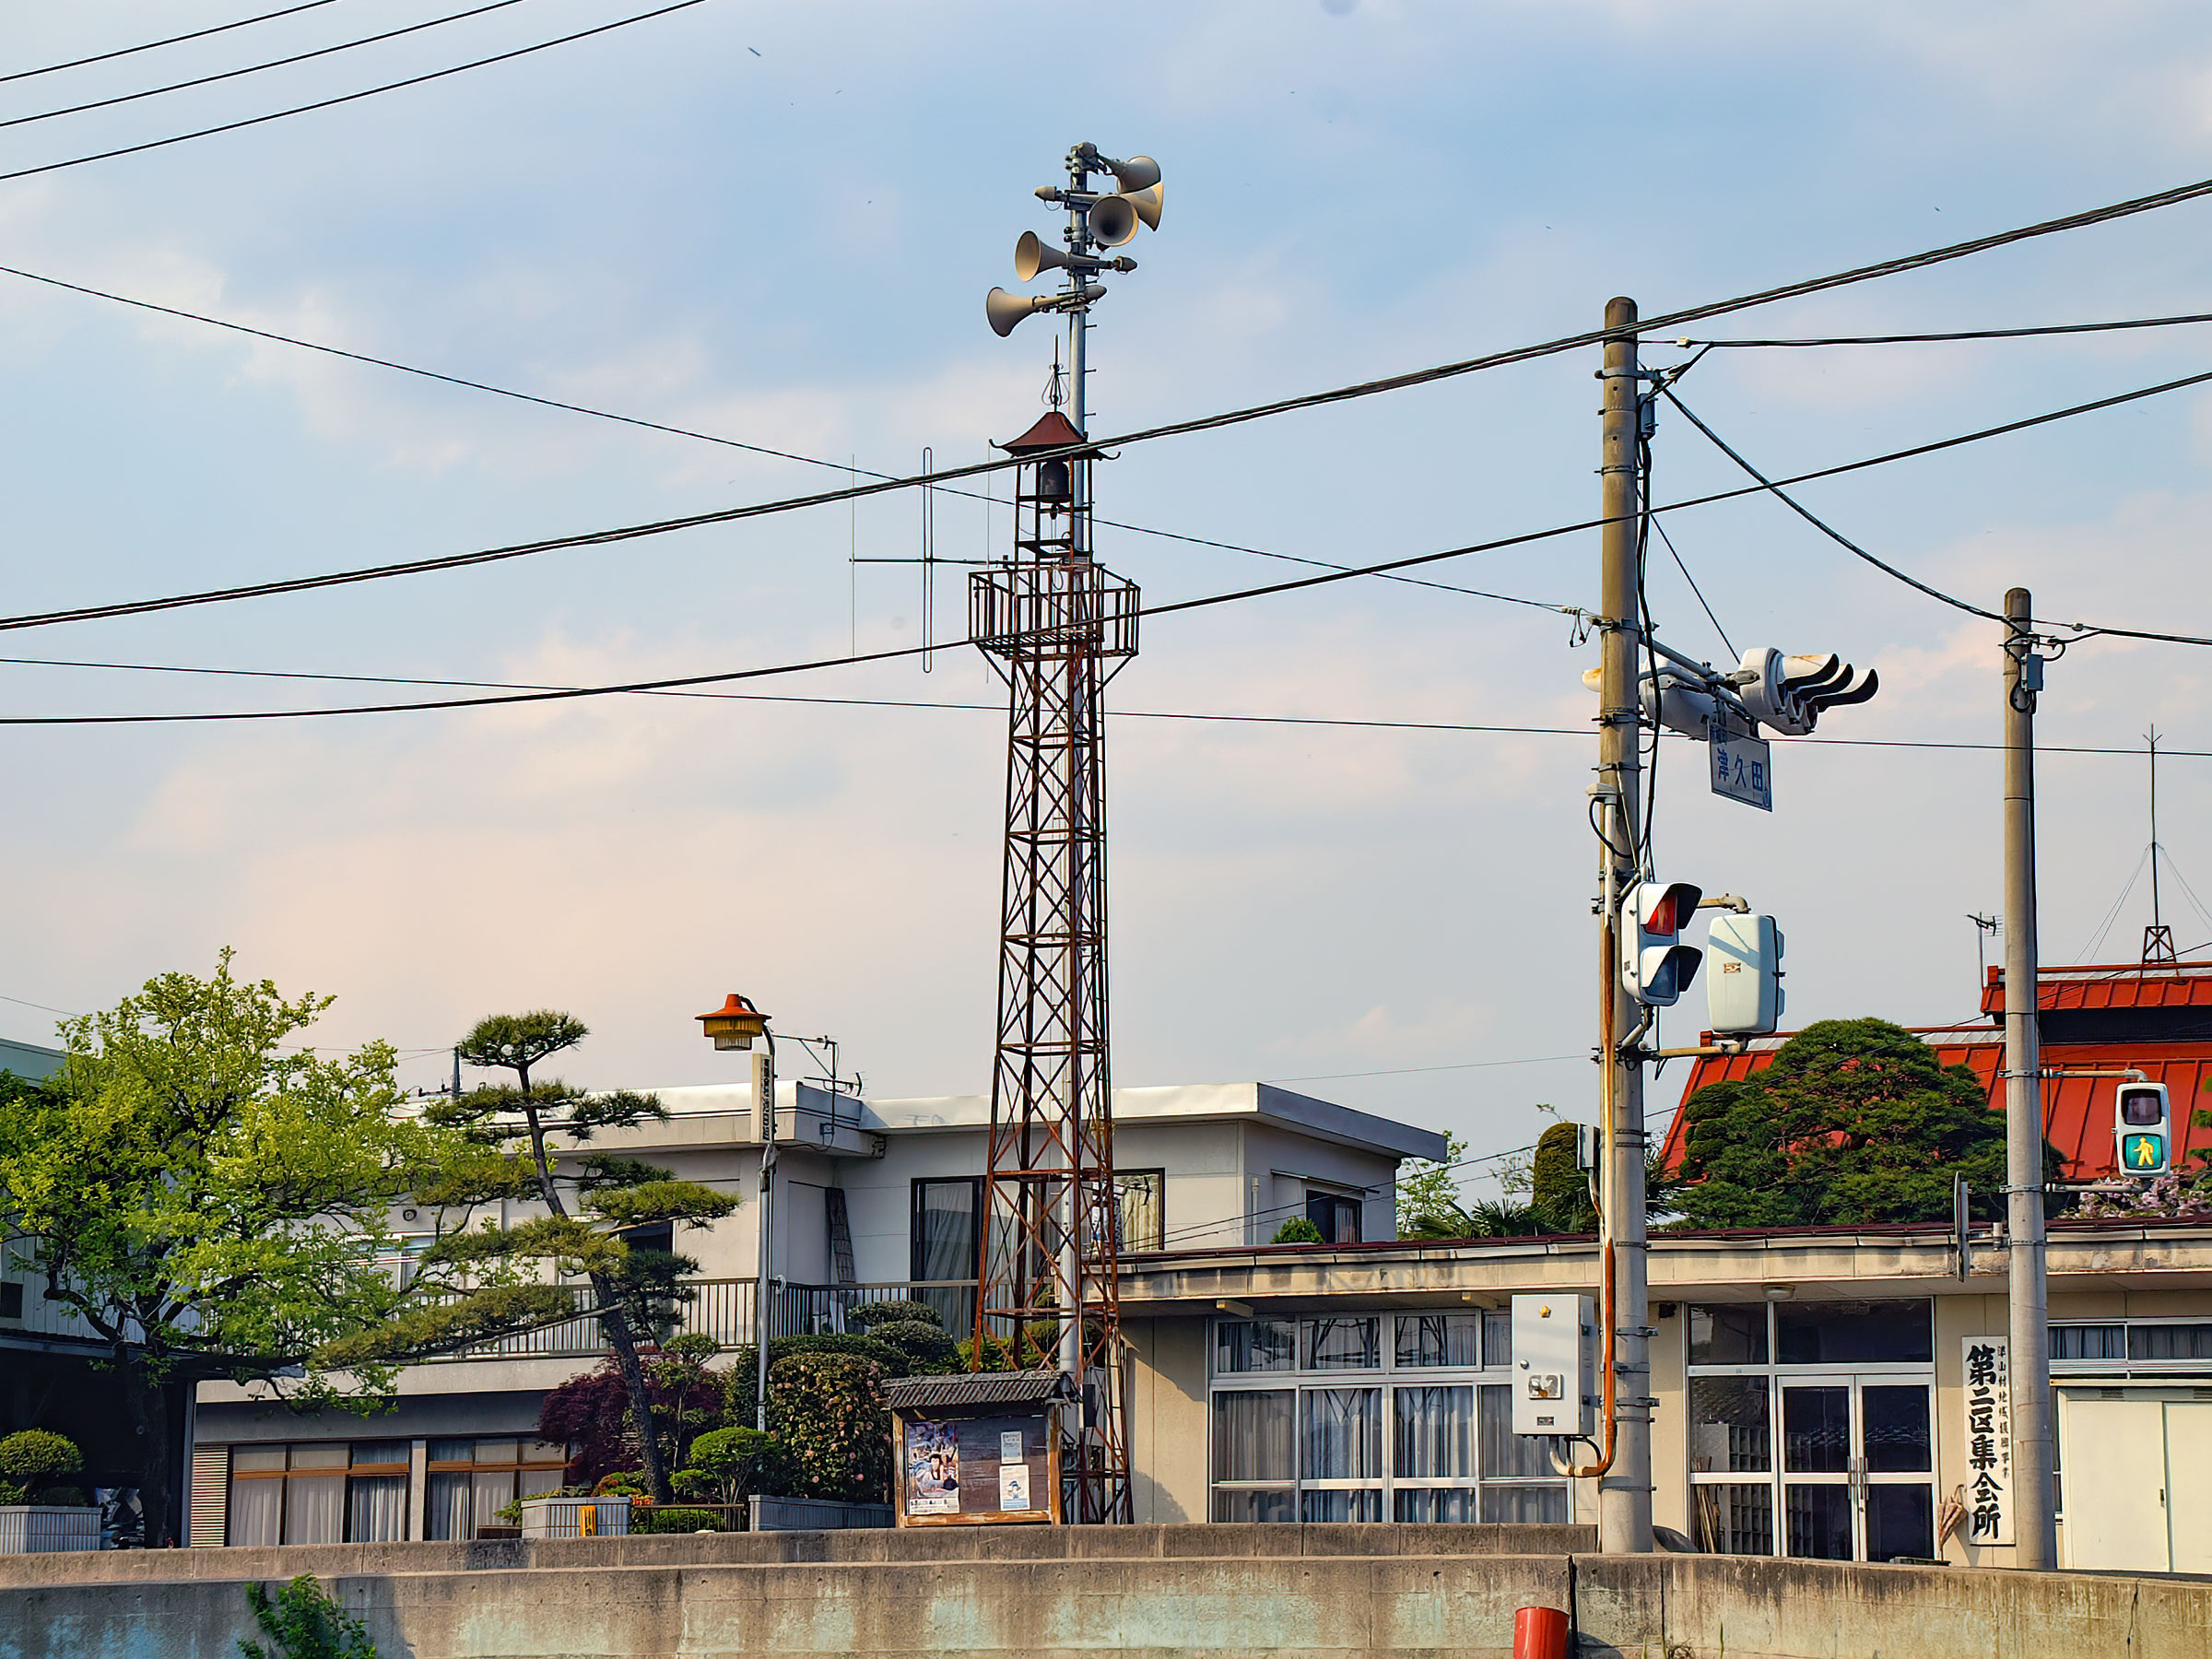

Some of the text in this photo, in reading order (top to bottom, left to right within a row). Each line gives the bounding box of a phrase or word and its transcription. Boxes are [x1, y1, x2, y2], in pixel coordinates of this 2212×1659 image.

[1717, 747, 1763, 792] 津久田
[1965, 1343, 2004, 1539] 第二区集会所
